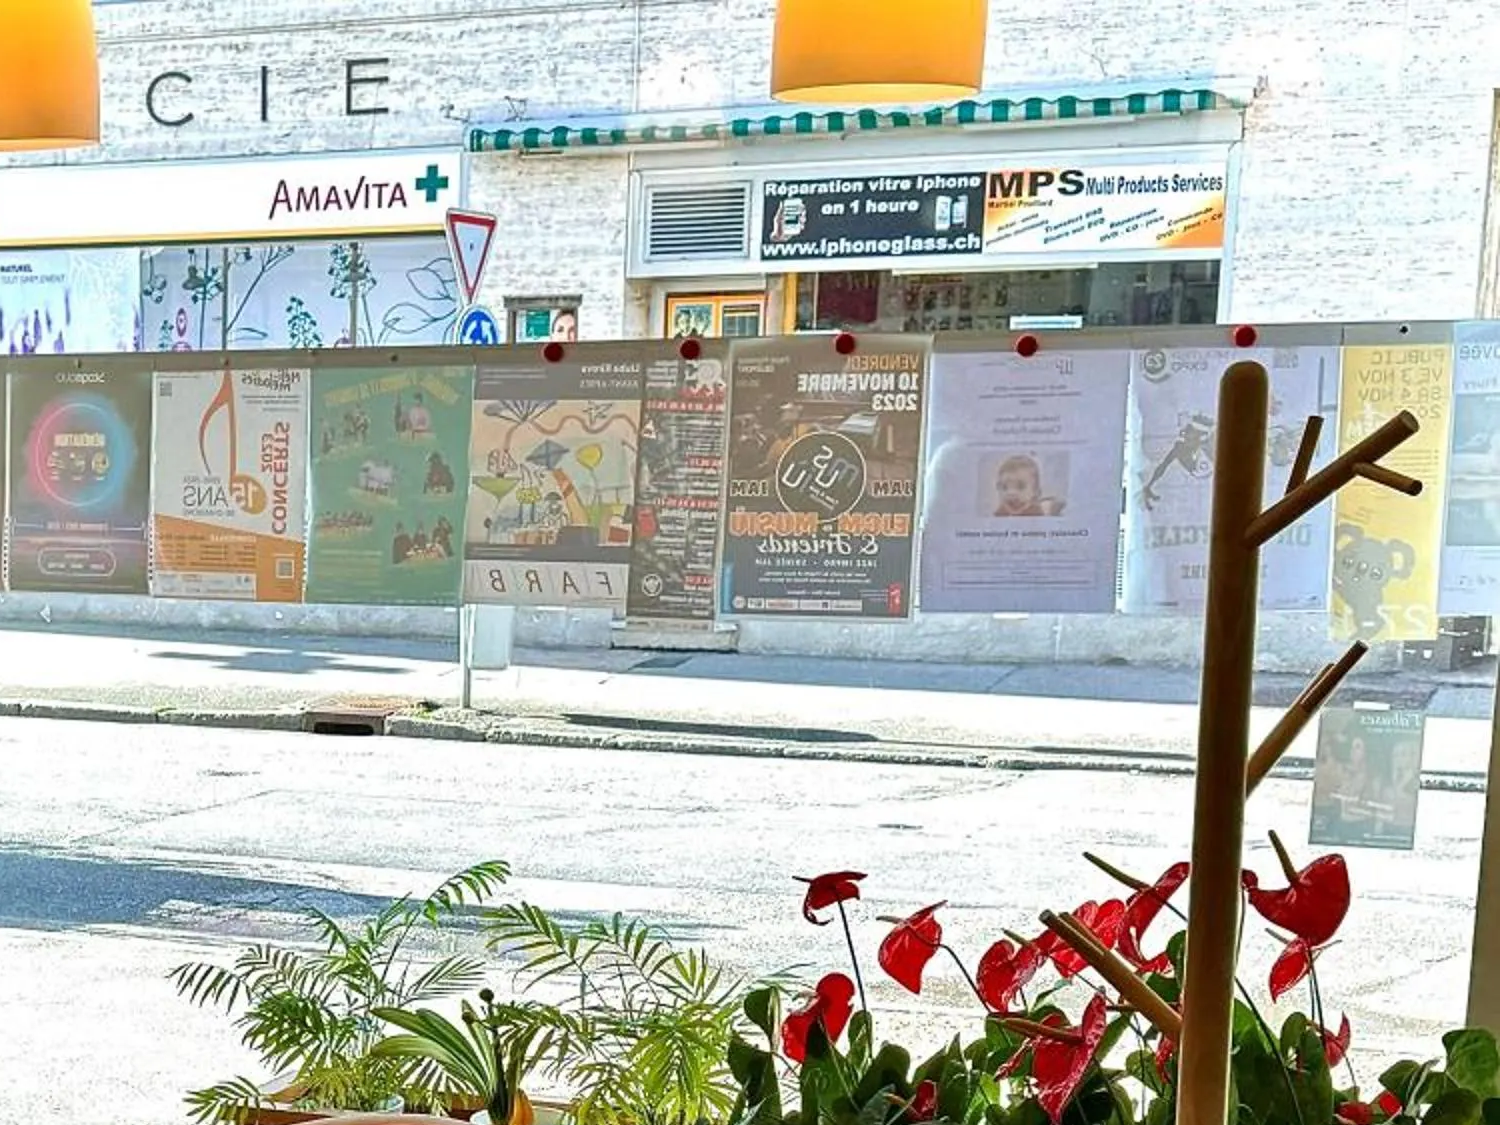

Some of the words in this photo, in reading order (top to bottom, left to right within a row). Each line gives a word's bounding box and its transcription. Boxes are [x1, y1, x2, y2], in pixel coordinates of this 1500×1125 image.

[867, 177, 912, 193] vitre
[987, 169, 1086, 199] MPS
[1086, 176, 1116, 197] Multi
[1117, 174, 1169, 195] Products
[1170, 171, 1223, 193] Services
[269, 177, 407, 220] AMAVITA
[820, 202, 845, 216] en
[850, 200, 859, 214] 1
[865, 197, 920, 213] heure
